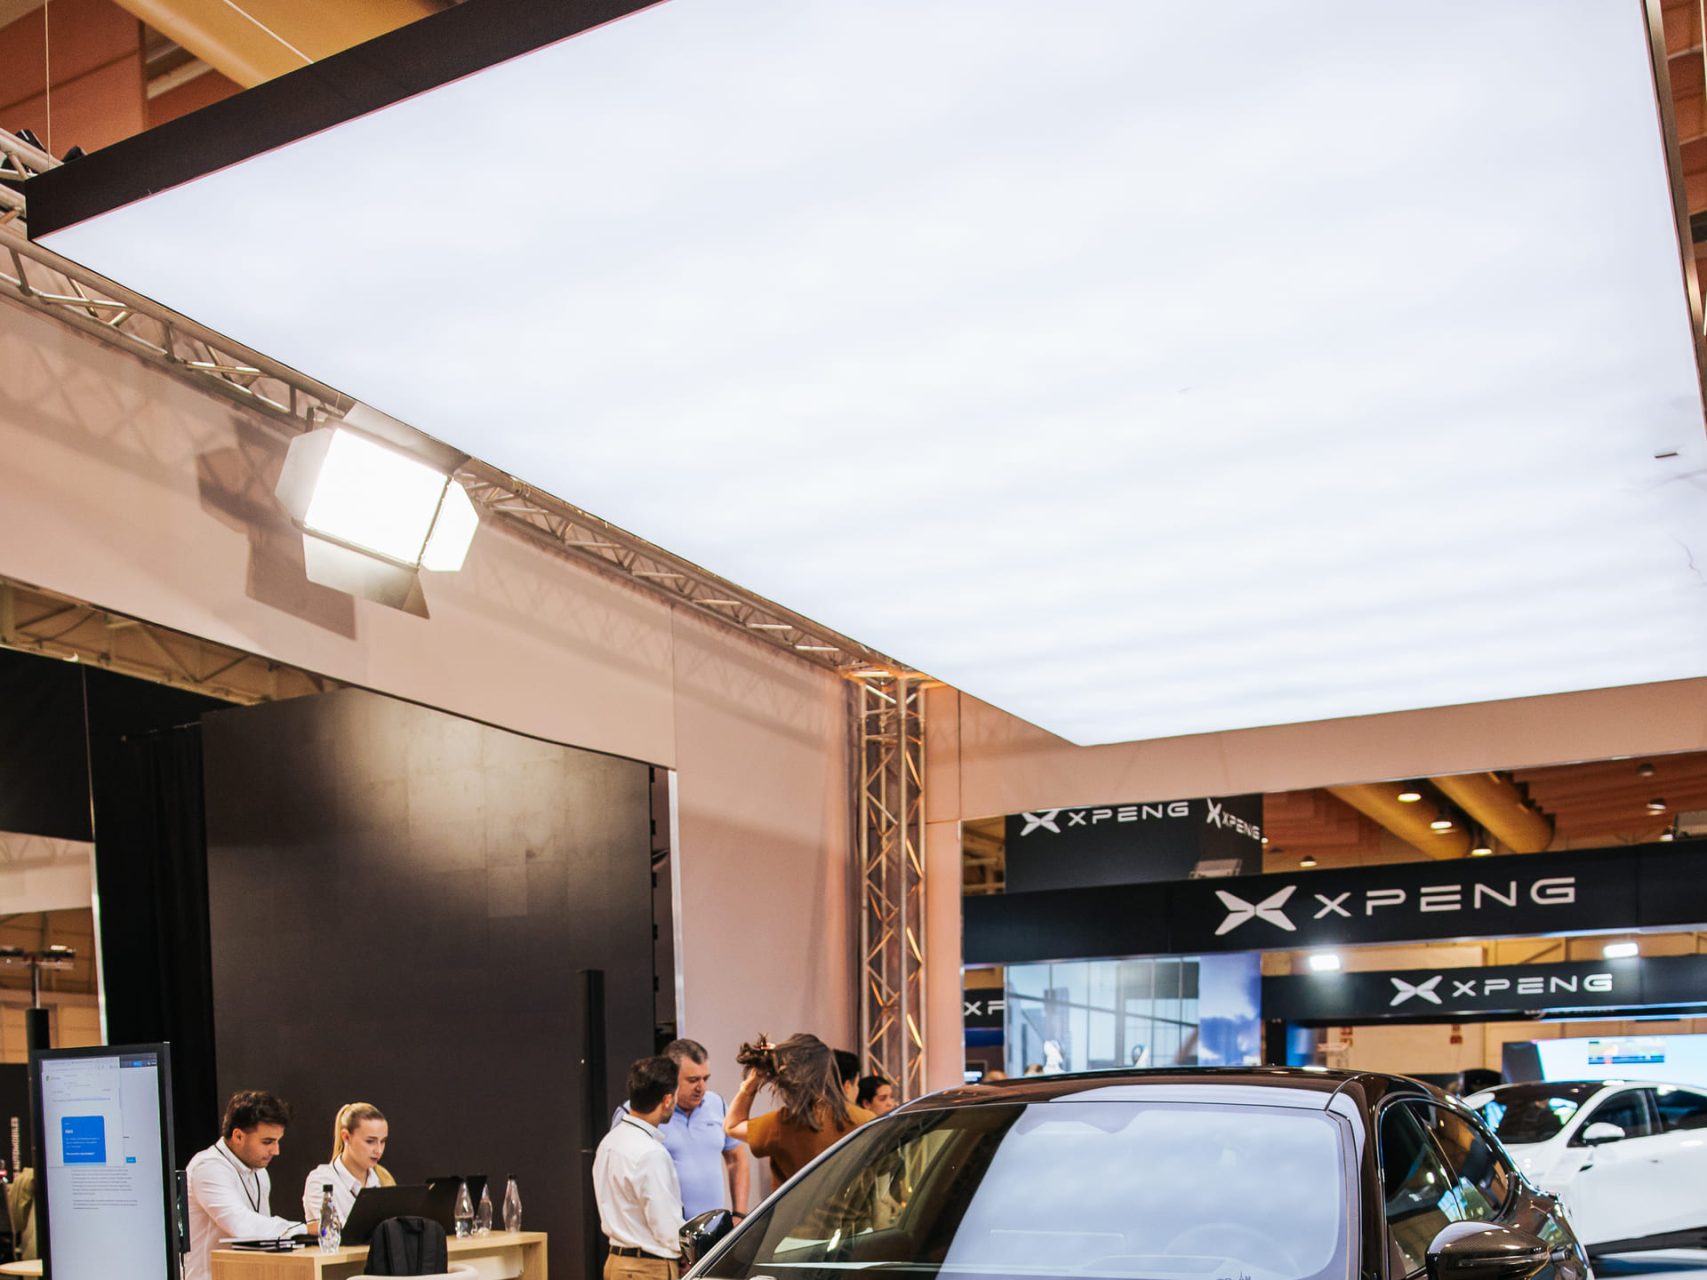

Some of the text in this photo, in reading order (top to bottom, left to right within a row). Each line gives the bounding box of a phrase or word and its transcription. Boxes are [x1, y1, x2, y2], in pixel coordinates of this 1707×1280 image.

[1067, 802, 1189, 827] XPENG
[1222, 811, 1260, 840] XPENG
[1313, 876, 1576, 919] XPENG
[1452, 973, 1613, 998] XPENG
